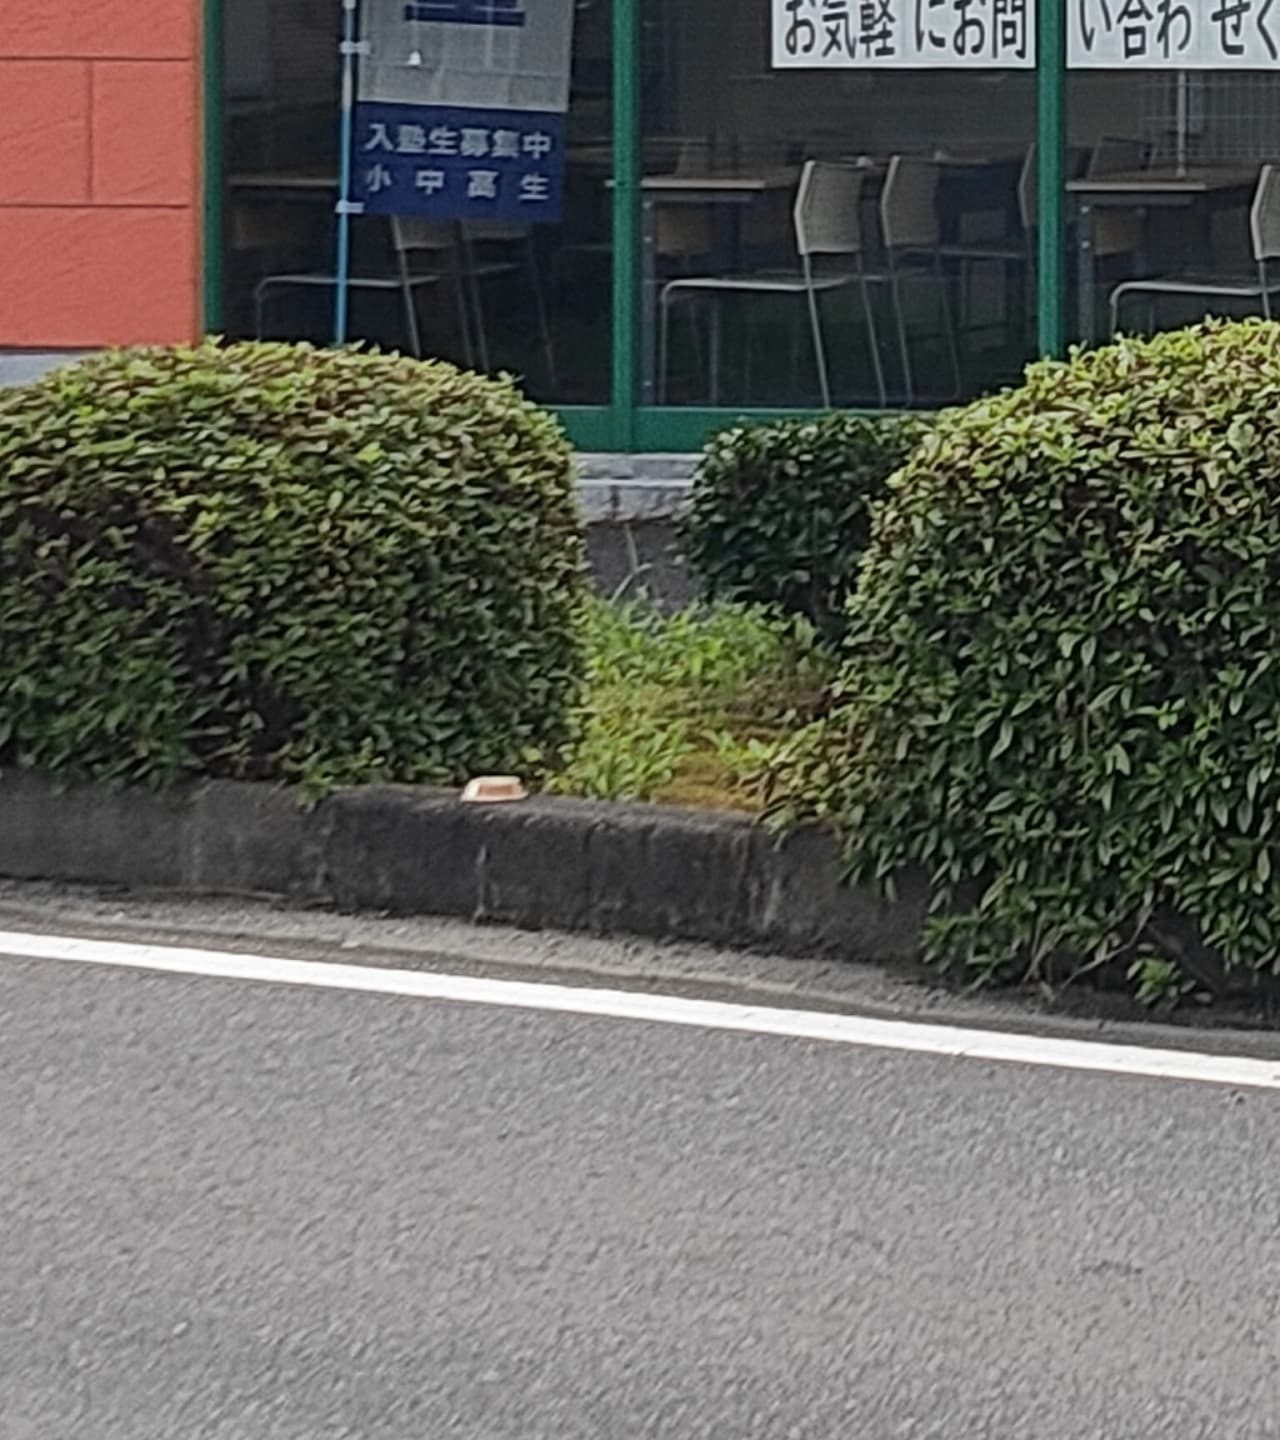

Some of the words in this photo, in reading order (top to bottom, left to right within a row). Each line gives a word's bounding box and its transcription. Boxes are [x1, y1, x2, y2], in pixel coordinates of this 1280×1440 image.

[362, 123, 553, 160] 入塾生募集中
[366, 164, 551, 202] 小中高生
